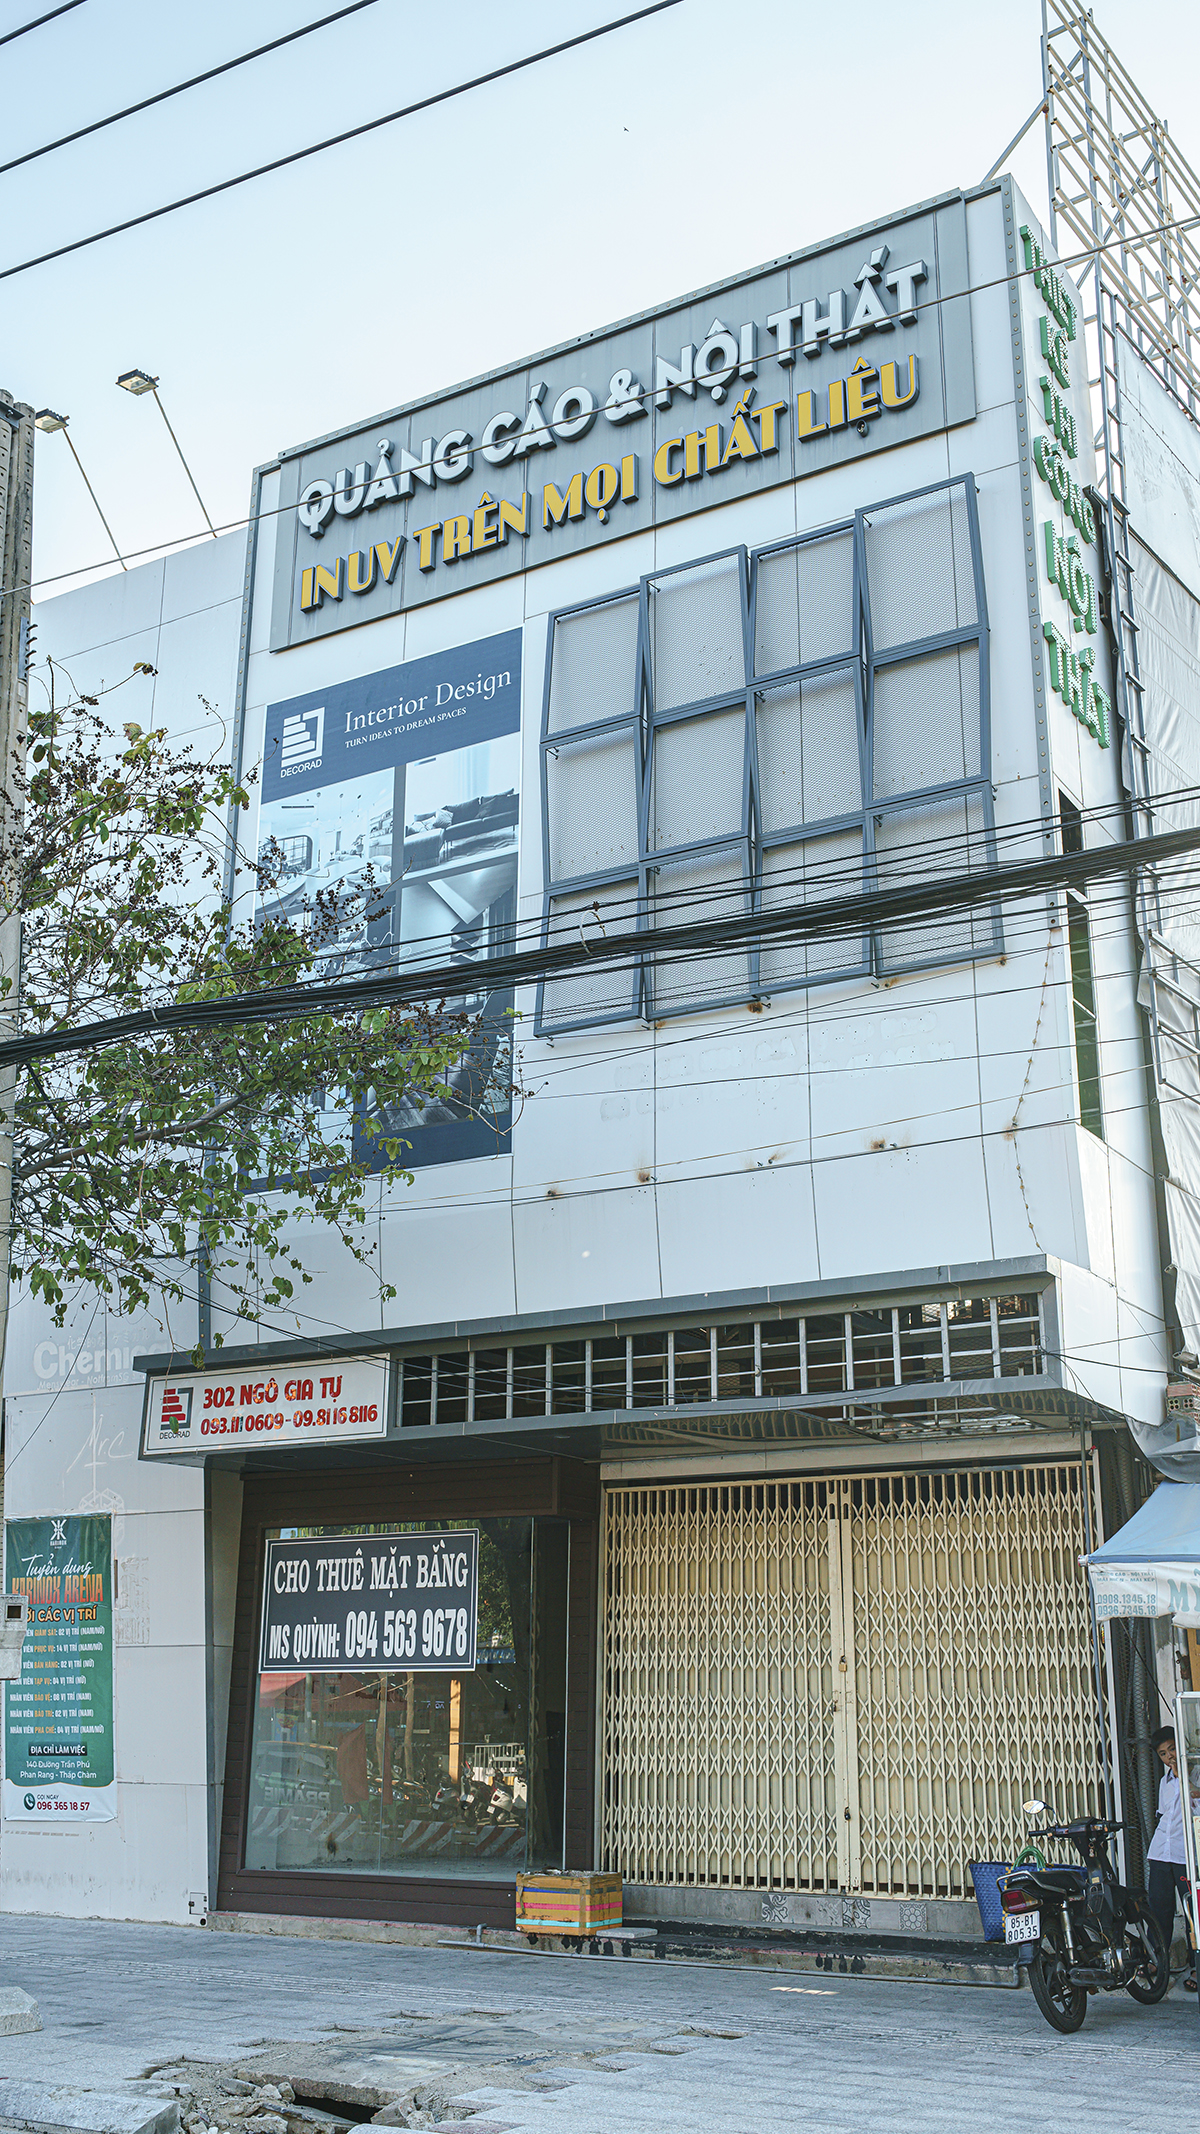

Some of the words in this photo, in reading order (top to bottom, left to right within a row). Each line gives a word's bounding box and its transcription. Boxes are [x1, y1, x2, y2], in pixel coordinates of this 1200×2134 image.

[299, 438, 472, 538] QUẢNG
[481, 381, 597, 467] CÁO
[605, 367, 648, 425] &
[655, 317, 759, 404] NỘI
[767, 245, 929, 366] THẤT
[1039, 375, 1078, 459] THI
[300, 556, 347, 614] IN
[348, 536, 406, 597] UV
[413, 491, 530, 573] TRÊN
[543, 453, 638, 526] MỌI
[653, 388, 787, 489] CHẤT
[797, 355, 919, 442] LIỆU
[1043, 621, 1112, 750] THẤT
[344, 696, 429, 733] Interior
[434, 670, 512, 706] Design
[345, 737, 368, 749] TURN
[369, 729, 392, 744] IDEAS
[393, 725, 406, 736] TO
[406, 715, 436, 732] DREAM
[437, 706, 467, 722] SPACES
[280, 758, 322, 778] DECORAD
[203, 1386, 235, 1408] 302
[240, 1378, 278, 1405] NGÔ
[284, 1379, 313, 1401] GIA
[320, 1375, 342, 1402] TỰ
[21, 1553, 60, 1580] Tuyển
[62, 1558, 94, 1578] dụng
[274, 1559, 310, 1594] CHO
[316, 1547, 364, 1592] THUÊ
[370, 1546, 412, 1598] MẶT
[416, 1539, 468, 1588] BẰNG
[12, 1576, 61, 1604] KARINOX
[64, 1574, 104, 1603] ARENA
[1097, 1594, 1156, 1604] 0908.1345.18
[37, 1606, 60, 1622] CÁC
[62, 1608, 75, 1624] VỊ
[77, 1604, 97, 1620] TRÍ
[1098, 1605, 1156, 1615] 0936.7345.18
[65, 1628, 70, 1637] VỊ
[269, 1624, 290, 1659] MS
[293, 1616, 340, 1662] QUỲNH:
[344, 1610, 378, 1658] 094
[382, 1609, 417, 1658] 563
[422, 1608, 468, 1657] 9678
[23, 1644, 33, 1652] VIÊN
[34, 1645, 46, 1653] PHỤC
[63, 1645, 68, 1653] VỊ
[23, 1660, 33, 1668] VIÊN
[68, 1661, 73, 1669] VỊ
[23, 1676, 33, 1685] VIÊN
[60, 1677, 65, 1686] VỊ
[66, 1675, 74, 1684] TRÍ
[10, 1693, 22, 1701] NHÂN
[23, 1693, 33, 1701] VIÊN
[61, 1693, 66, 1702] VỊ
[67, 1692, 75, 1700] TRÍ
[76, 1692, 92, 1701] (NAM)
[10, 1709, 22, 1717] NHÂN
[23, 1709, 33, 1717] VIÊN
[62, 1709, 68, 1718] VỊ
[69, 1708, 77, 1717] TRÍ
[78, 1709, 94, 1717] (NAM)
[10, 1725, 22, 1734] NHÂN
[23, 1725, 34, 1734] VIÊN
[64, 1726, 70, 1735] VỊ
[71, 1724, 79, 1733] TRÍ
[30, 1746, 42, 1755] ĐỊA
[56, 1744, 69, 1754] LÀM
[70, 1744, 85, 1755] VIỆC
[38, 1771, 54, 1780] Rang
[60, 1771, 76, 1779] Tháp
[37, 1802, 52, 1811] 096
[54, 1802, 68, 1810] 365
[70, 1802, 78, 1810] 18
[80, 1802, 90, 1811] 57
[1010, 1914, 1033, 1929] 85-B1
[1008, 1926, 1038, 1941] 805.35
